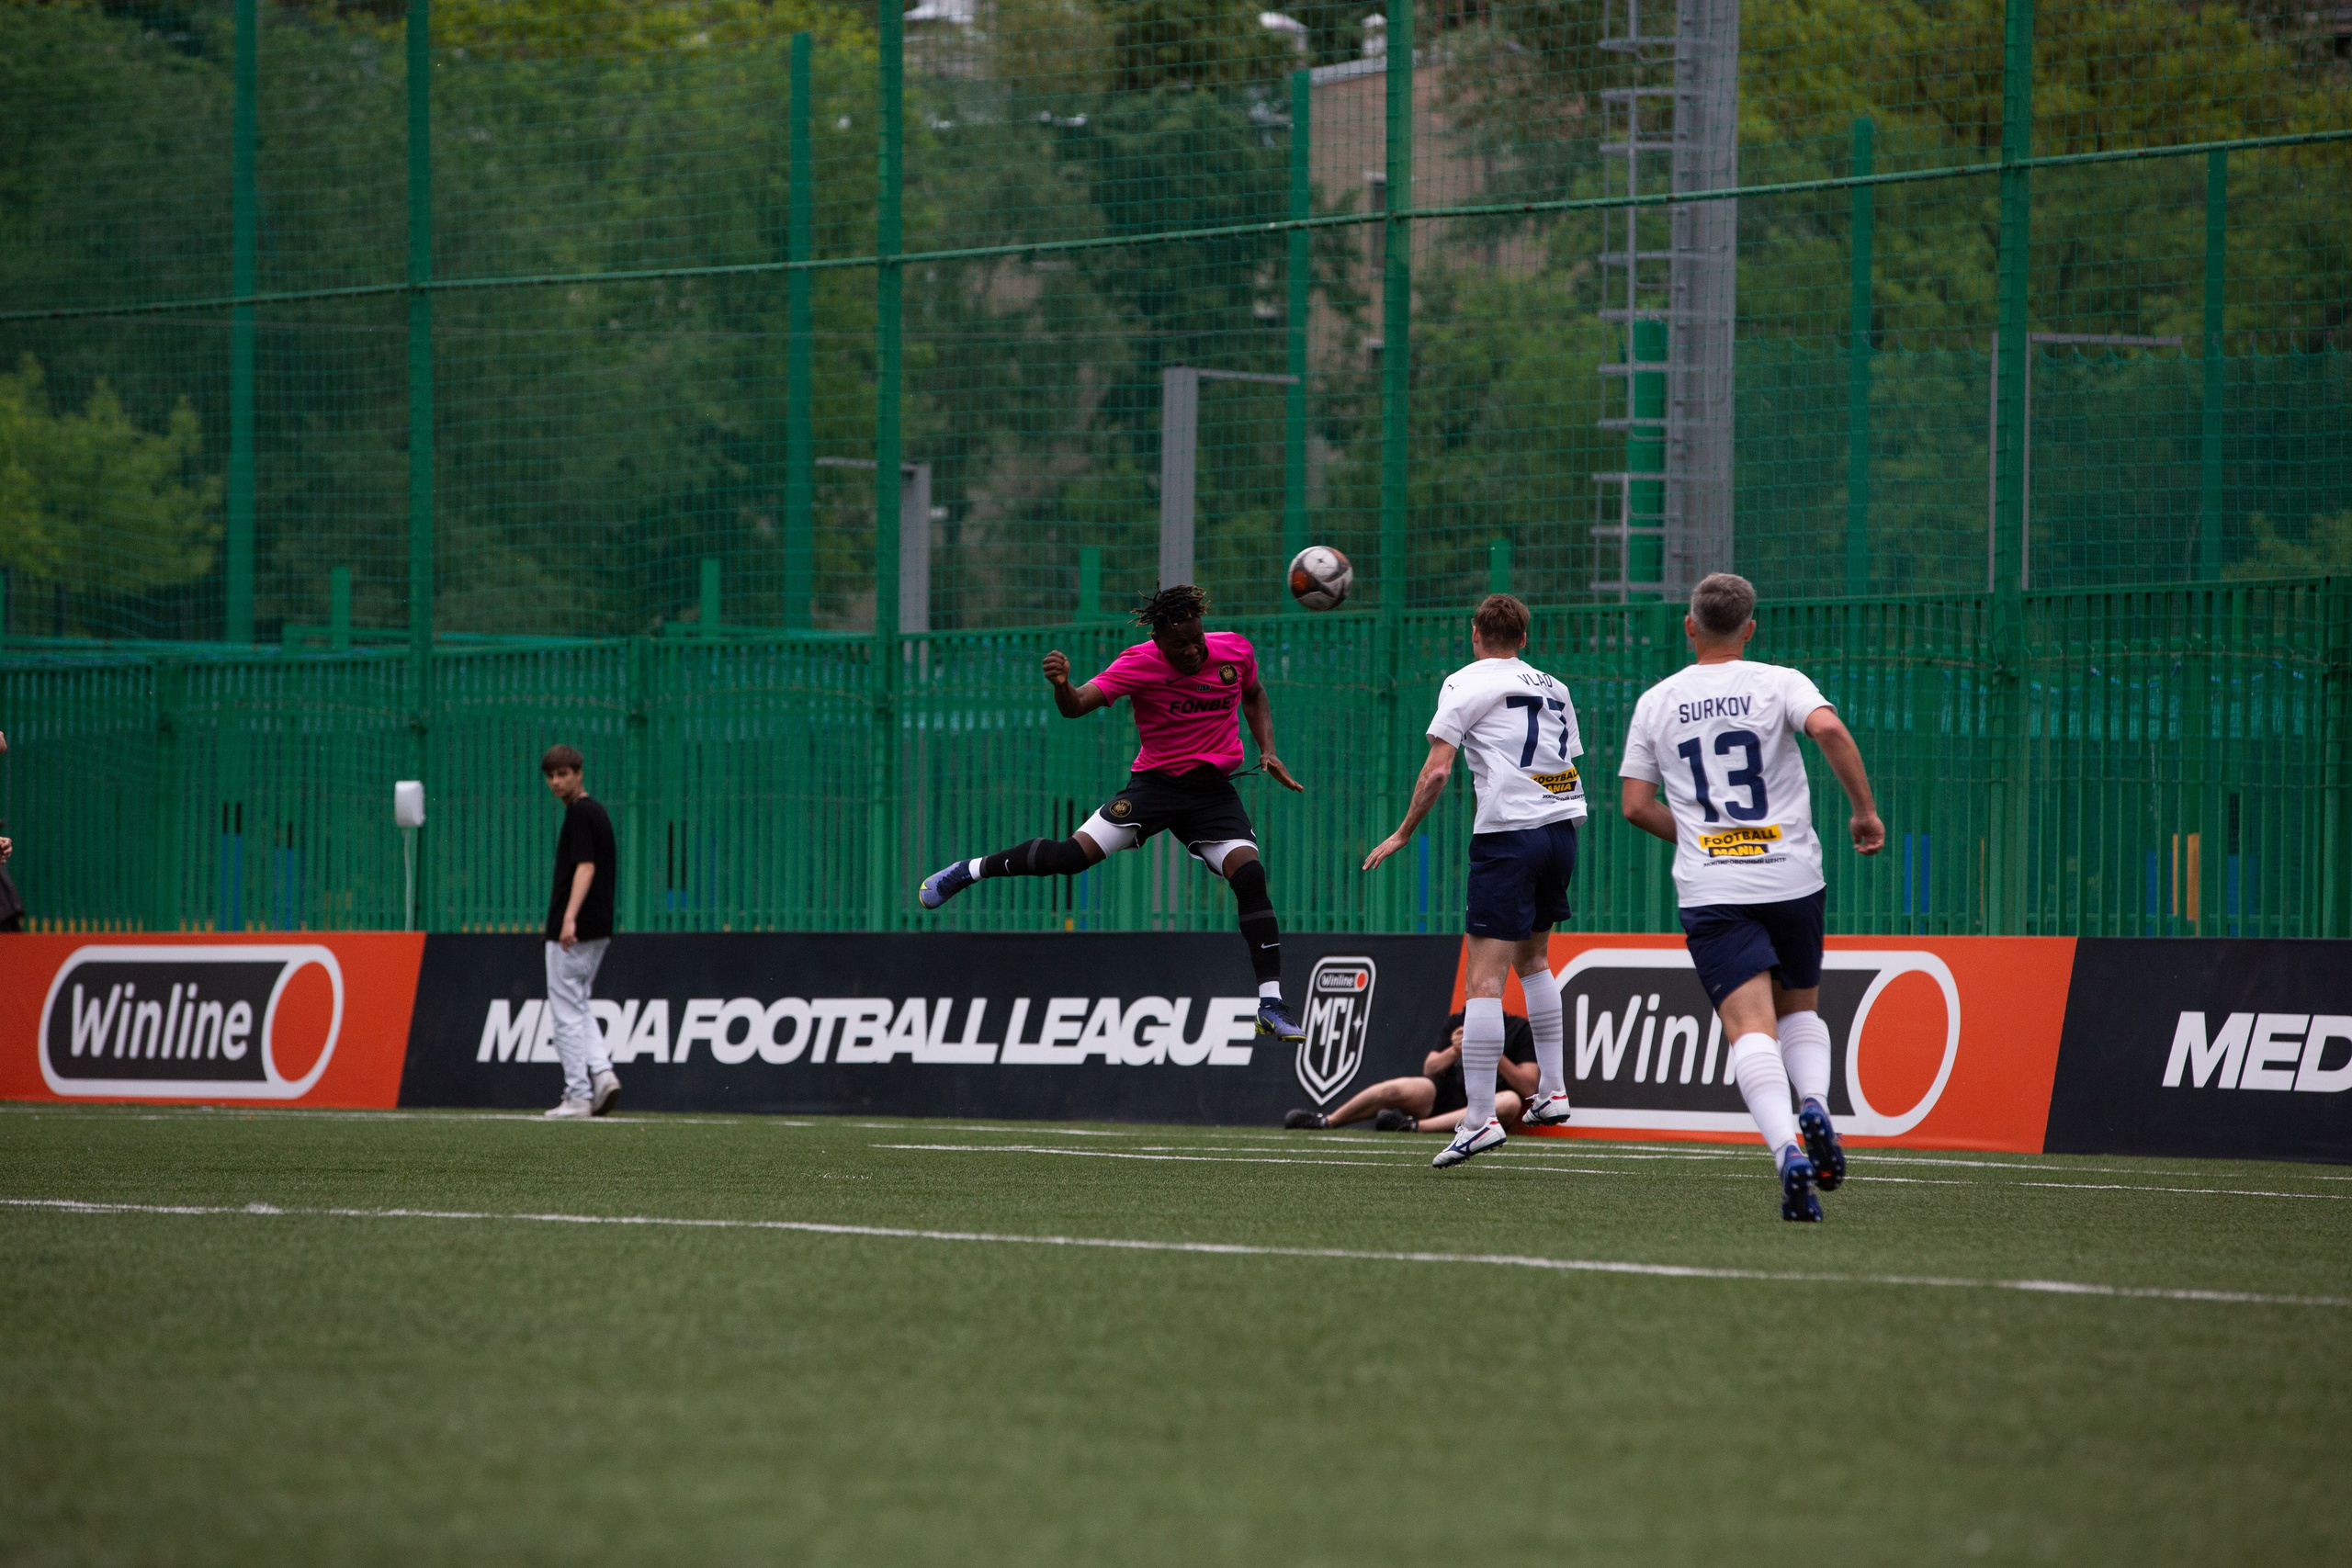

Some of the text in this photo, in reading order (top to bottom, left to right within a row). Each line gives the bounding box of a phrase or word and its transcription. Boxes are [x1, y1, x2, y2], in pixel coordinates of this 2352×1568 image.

[1517, 673, 1554, 688] VLAD
[1679, 695, 1752, 724] SURKOV
[1506, 695, 1569, 768] 77
[1544, 783, 1572, 793] ANIA
[1678, 729, 1769, 823] 13
[1703, 829, 1777, 846] FOOTBALL
[1712, 844, 1766, 856] MANIA
[1320, 973, 1354, 987] Winline
[71, 982, 254, 1062] Winline
[673, 996, 1001, 1065] FOOTBALL
[1000, 996, 1261, 1066] LEAGUE
[1303, 997, 1356, 1093] MFL
